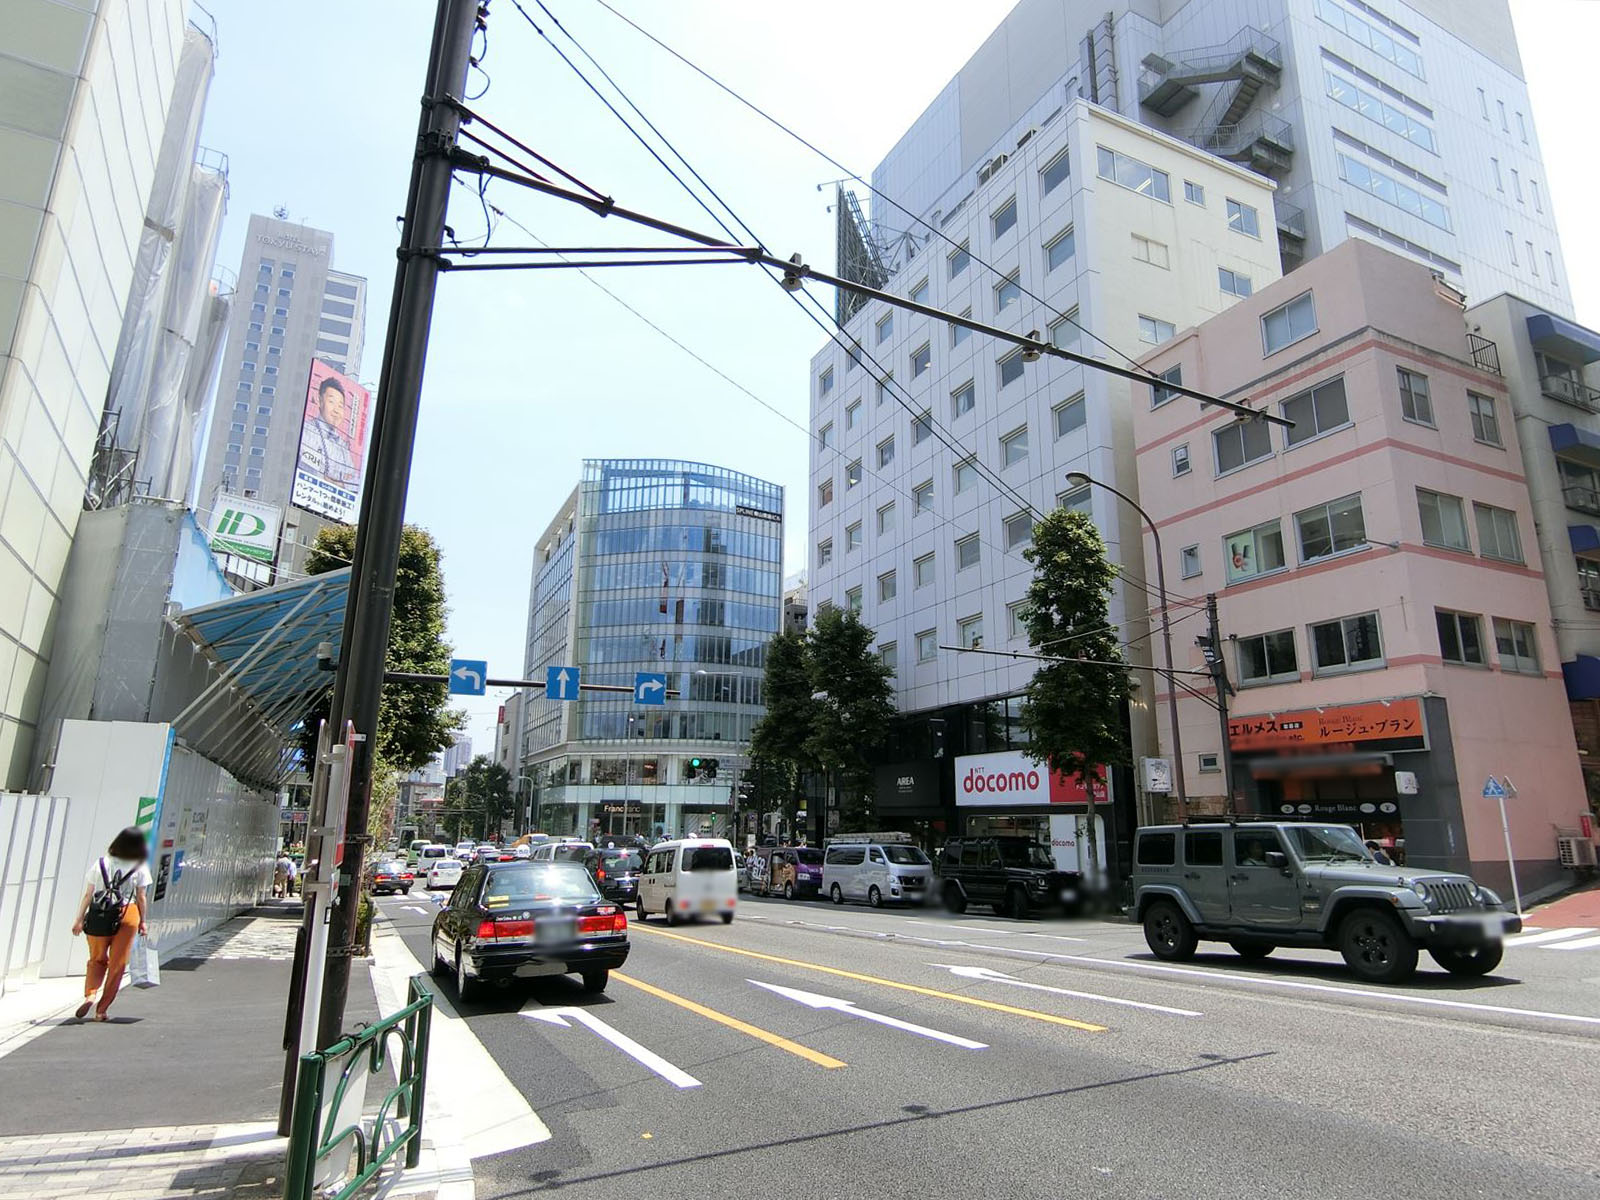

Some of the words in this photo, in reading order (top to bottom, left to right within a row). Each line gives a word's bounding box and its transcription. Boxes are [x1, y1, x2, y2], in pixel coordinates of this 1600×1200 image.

[1230, 721, 1278, 736] エルメス
[1320, 719, 1416, 738] ルージュ・ブラン
[897, 776, 914, 786] AREA
[963, 768, 1040, 793] docomo
[1314, 804, 1336, 813] Rouge
[1337, 803, 1357, 812] Blanc
[1051, 838, 1075, 847] docomo
